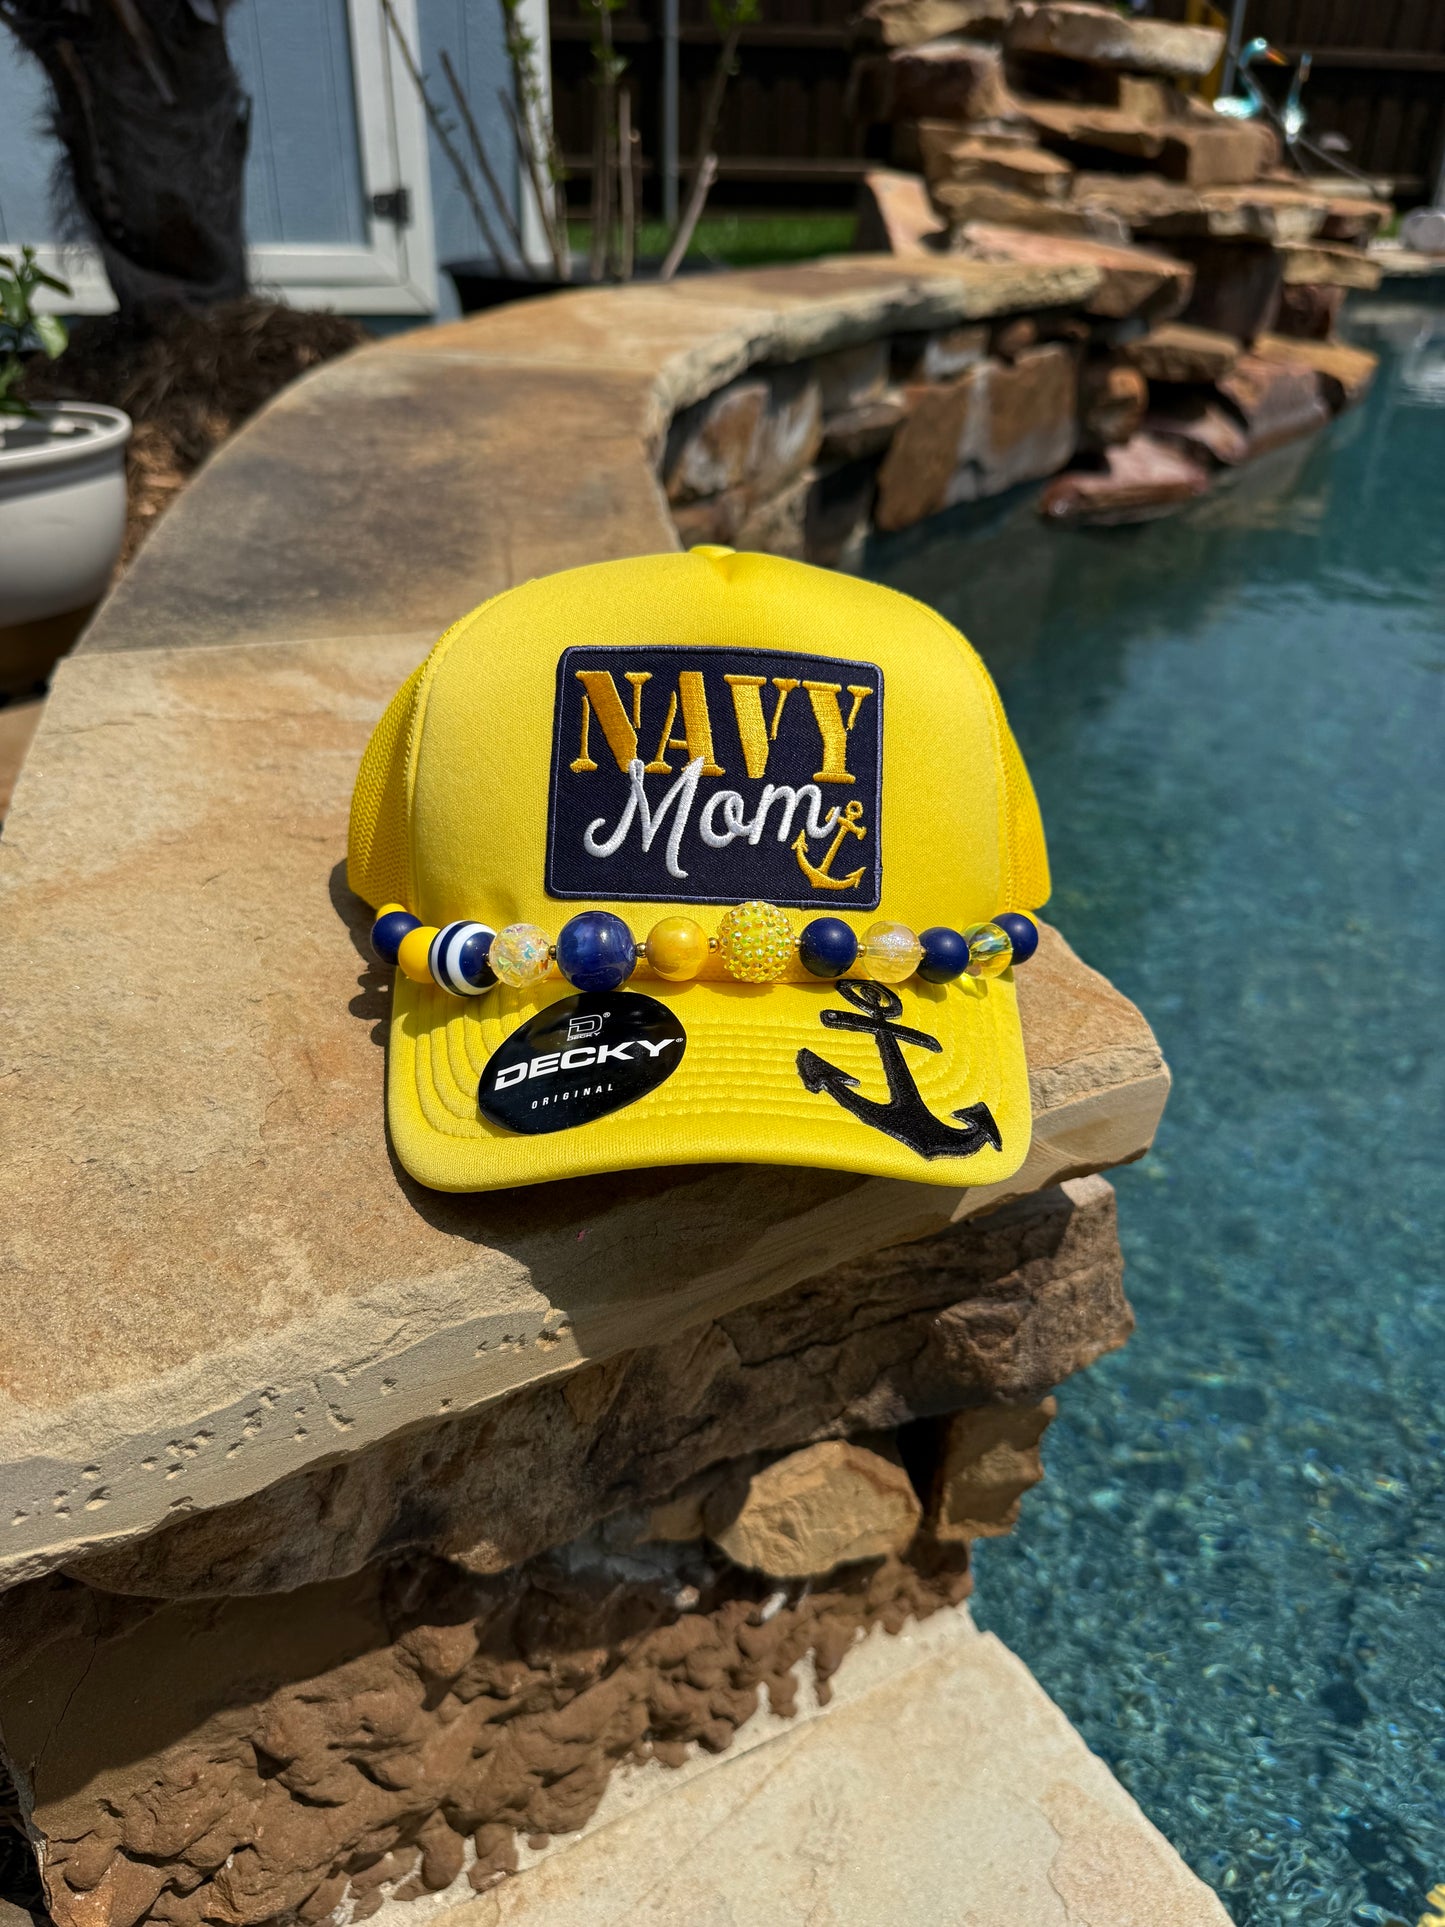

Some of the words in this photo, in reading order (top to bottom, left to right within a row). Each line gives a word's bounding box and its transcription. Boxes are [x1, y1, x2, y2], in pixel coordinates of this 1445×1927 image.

[570, 671, 874, 783] NAVY
[585, 756, 841, 878] Mom
[531, 1083, 614, 1110] ORIGINAL
